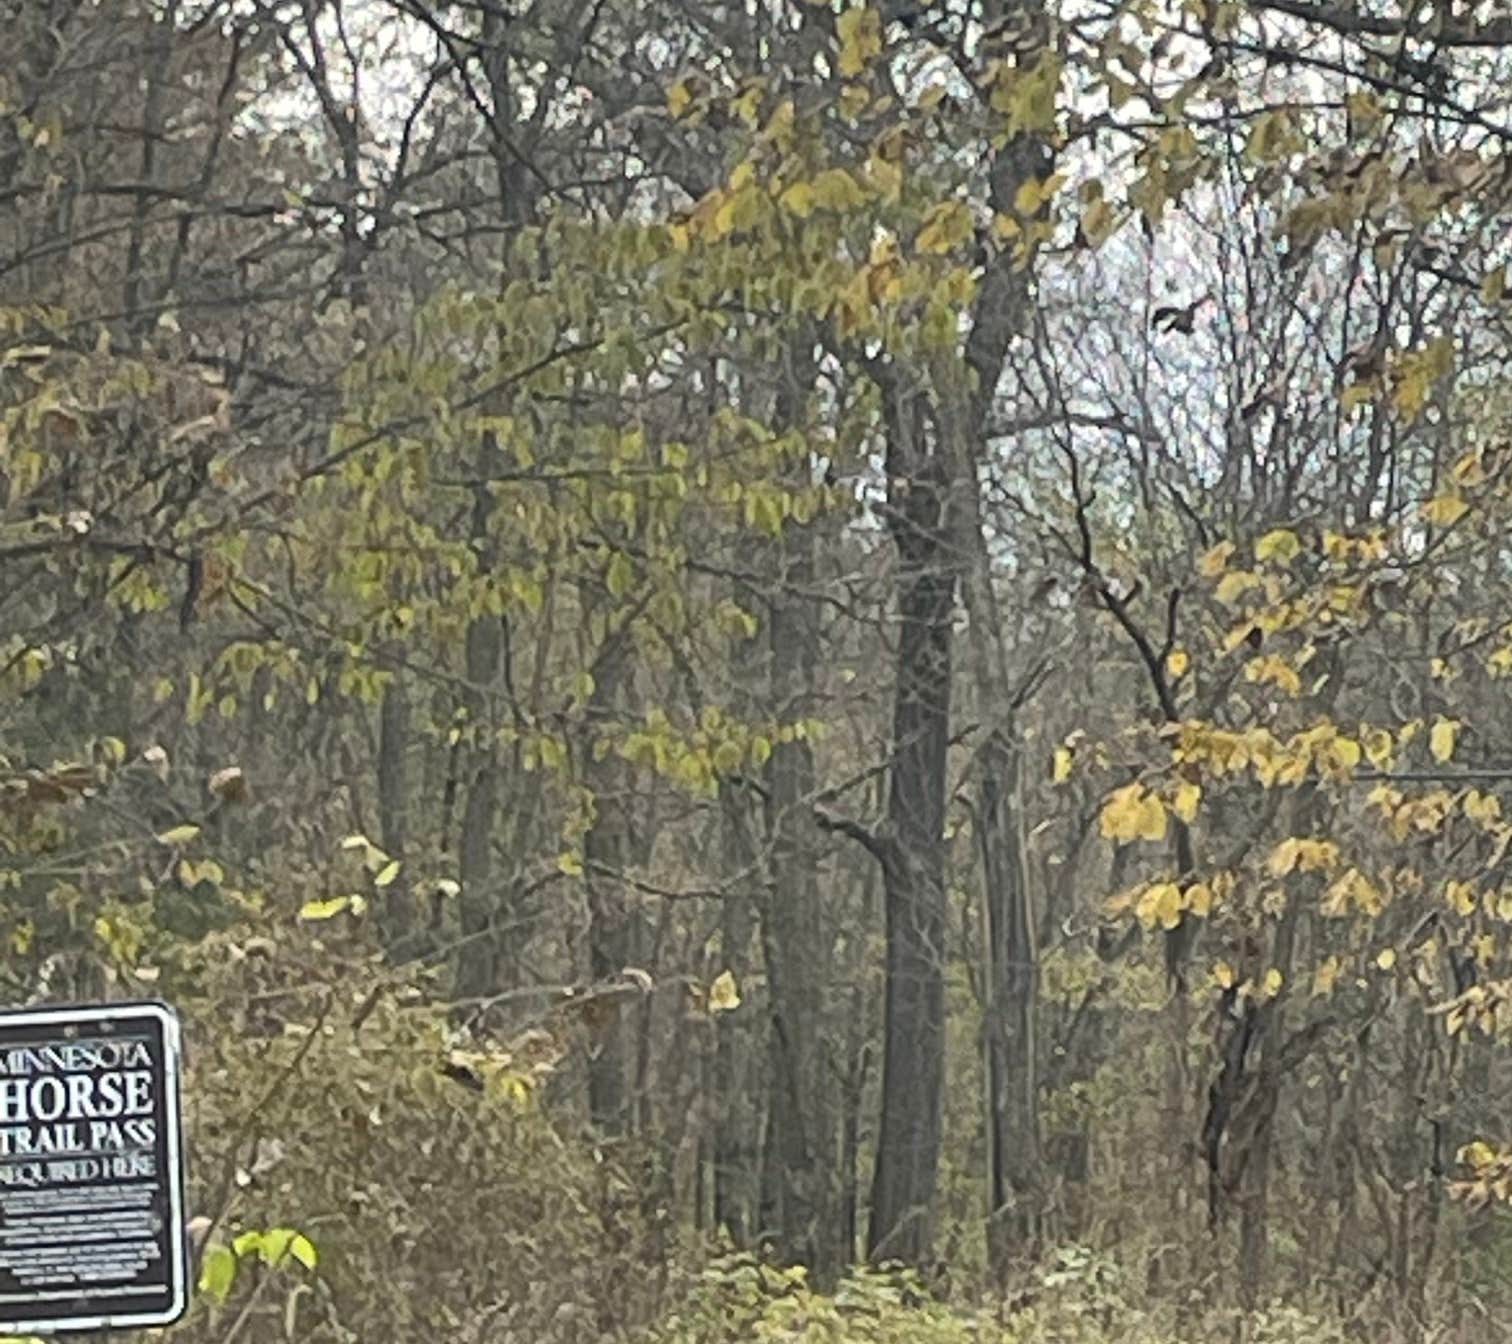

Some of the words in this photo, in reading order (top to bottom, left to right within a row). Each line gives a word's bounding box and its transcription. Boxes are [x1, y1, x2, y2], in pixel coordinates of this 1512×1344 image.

[0, 1070, 155, 1122] HORSE
[0, 1123, 84, 1154] TRAIL
[90, 1119, 156, 1152] PASS
